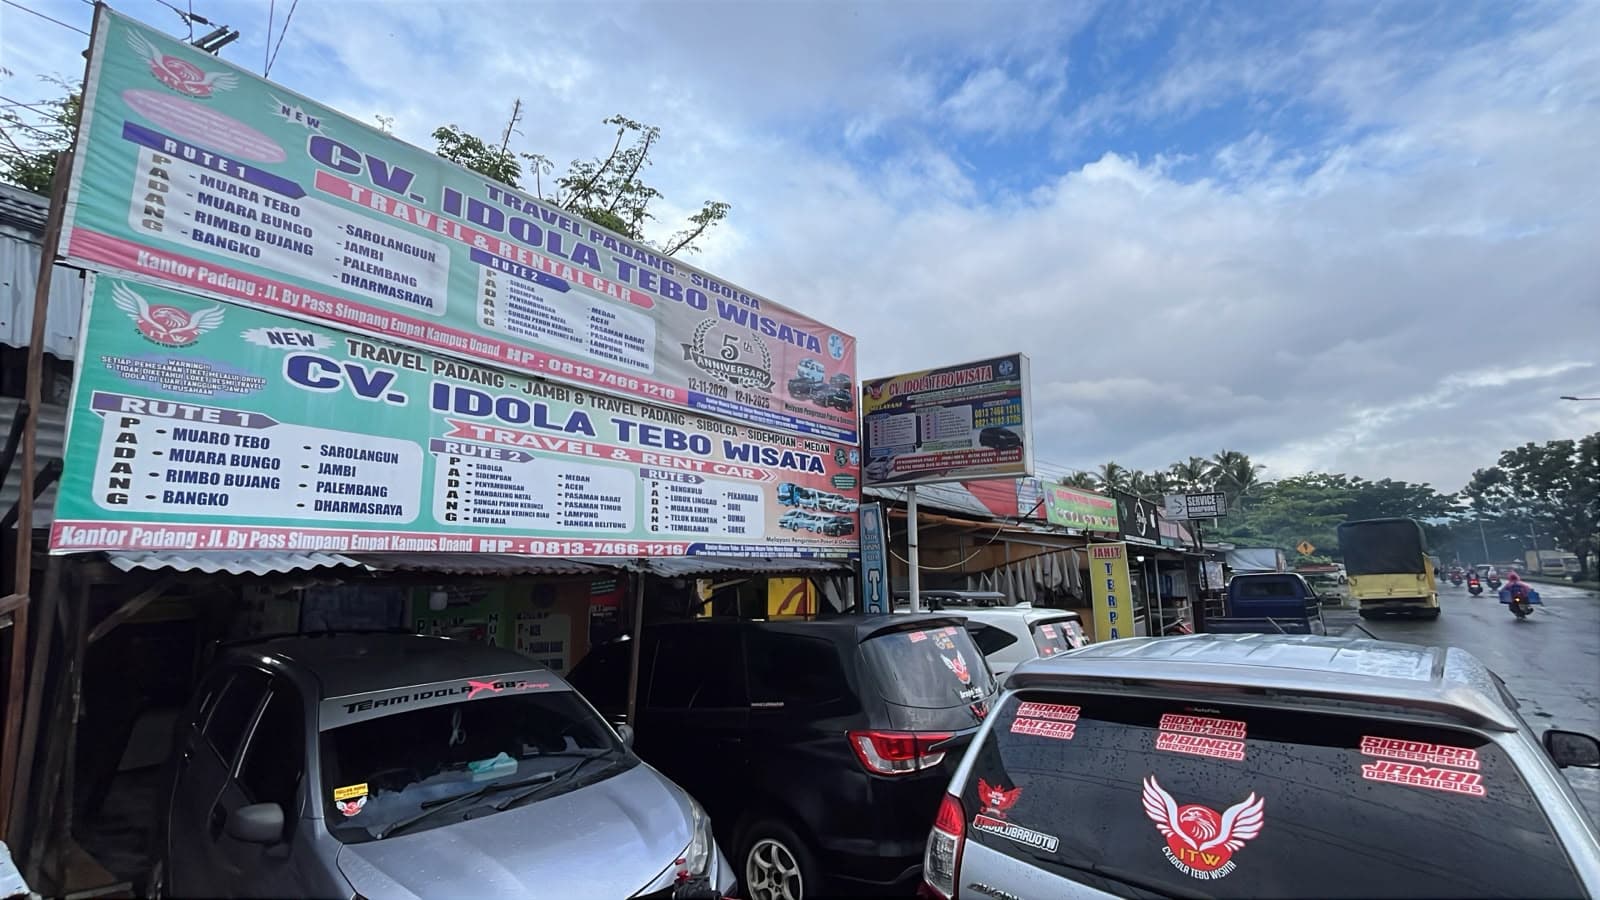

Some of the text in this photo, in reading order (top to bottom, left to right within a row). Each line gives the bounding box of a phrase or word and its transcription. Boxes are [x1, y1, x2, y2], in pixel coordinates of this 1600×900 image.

[281, 105, 320, 129] NEW
[163, 138, 246, 178] RUTE 1
[142, 153, 173, 233] PADANG
[200, 174, 301, 218] MUARA TEBO
[198, 191, 313, 238] MUARA BUNGO
[191, 228, 261, 258] BANGKO
[194, 210, 314, 257] RIMBO BUJANG
[309, 134, 822, 354] CV. IDOLA TEBO WISATA
[348, 183, 631, 302] TRAVEL & RENTAL CAR
[343, 240, 384, 262] JAMBI
[485, 184, 760, 310] TRAVEL PADANG SIBOLGA
[343, 255, 418, 287] PALEMBANG
[491, 257, 538, 281] RUTE 2
[340, 272, 434, 309] DHARMASRAYA
[136, 250, 194, 280] Kantor
[197, 267, 254, 296] Padang
[282, 287, 300, 306] By
[301, 293, 333, 315] Pass
[335, 300, 388, 329] Simpang
[390, 315, 425, 337] Empat
[425, 325, 468, 350] Kampus
[469, 338, 500, 357] Unand
[506, 347, 535, 364] HP
[548, 358, 595, 380] 0813
[265, 330, 316, 347] NEW
[720, 334, 740, 360] 5
[696, 356, 769, 383] ANNIVERSARY
[903, 377, 930, 393] IDOLA
[930, 372, 955, 390] TEBO
[955, 365, 993, 386] WISATA
[347, 339, 427, 372] TRAVEL
[433, 359, 505, 389] PADANG
[522, 381, 570, 403] JAMBI
[574, 393, 584, 405] &
[590, 397, 638, 418] TRAVEL
[641, 407, 685, 426] PADANG
[696, 419, 738, 437] SIBOLGA
[748, 429, 797, 448] SIDEMPUAN
[804, 440, 830, 454] MEDAN
[688, 377, 728, 398] 12-11-2020
[120, 397, 250, 427] RUTE 1
[287, 354, 825, 474] CV. IDOLA TEBO WISATA
[172, 427, 271, 450] MUARO TEBO
[105, 416, 142, 506] PADANG
[169, 447, 281, 471] MUARA BUNGO
[320, 444, 399, 465] SAROLANGUN
[444, 441, 521, 462] RUTE 2
[475, 425, 755, 479] TRAVEL & RENT CAR
[166, 468, 281, 490] RIMBO BUJANG
[317, 463, 357, 478] JAMBI
[475, 463, 503, 473] SIBOLGA
[565, 473, 590, 483] MEDAN
[648, 469, 697, 483] RUTE 3
[162, 490, 229, 507] BANGKO
[316, 481, 388, 498] PALEMBANG
[444, 456, 461, 522] PADANG
[474, 490, 513, 500] MANDAILING
[564, 483, 584, 491] ACEH
[564, 491, 622, 503] PASAMAN BARAT
[670, 485, 703, 495] BENGKULU
[727, 491, 759, 502] PEKANBARU
[313, 499, 403, 517] DHARMASRAYA
[473, 498, 498, 507] SUNGAI
[564, 501, 599, 511] PASAMAN
[651, 481, 659, 532] PADANG
[670, 505, 693, 513] MUARA
[1187, 495, 1216, 506] SERVICE
[563, 511, 599, 519] LAMPUNG
[563, 520, 627, 529] BANGKA BELITUNG
[670, 514, 690, 522] TELUK
[59, 526, 128, 547] Kantor
[129, 528, 198, 550] Padang
[227, 530, 247, 551] By
[249, 532, 285, 549] Pass
[288, 532, 349, 552] Simpang
[351, 534, 389, 552] Empat
[391, 535, 437, 553] Kampus
[439, 537, 473, 552] Unand
[479, 539, 514, 553] HP
[530, 541, 684, 558] 0813-7466-1216
[343, 685, 474, 714] TEAM IDOLA
[1020, 703, 1079, 715] PADANG
[1162, 715, 1245, 731] SIDEMPUAN
[1362, 737, 1474, 760] SIBOLGA
[1363, 761, 1481, 785] JAMBI
[1180, 848, 1220, 866] ITW
[1190, 868, 1210, 880] TEBO
[1210, 860, 1237, 880] WISATA
